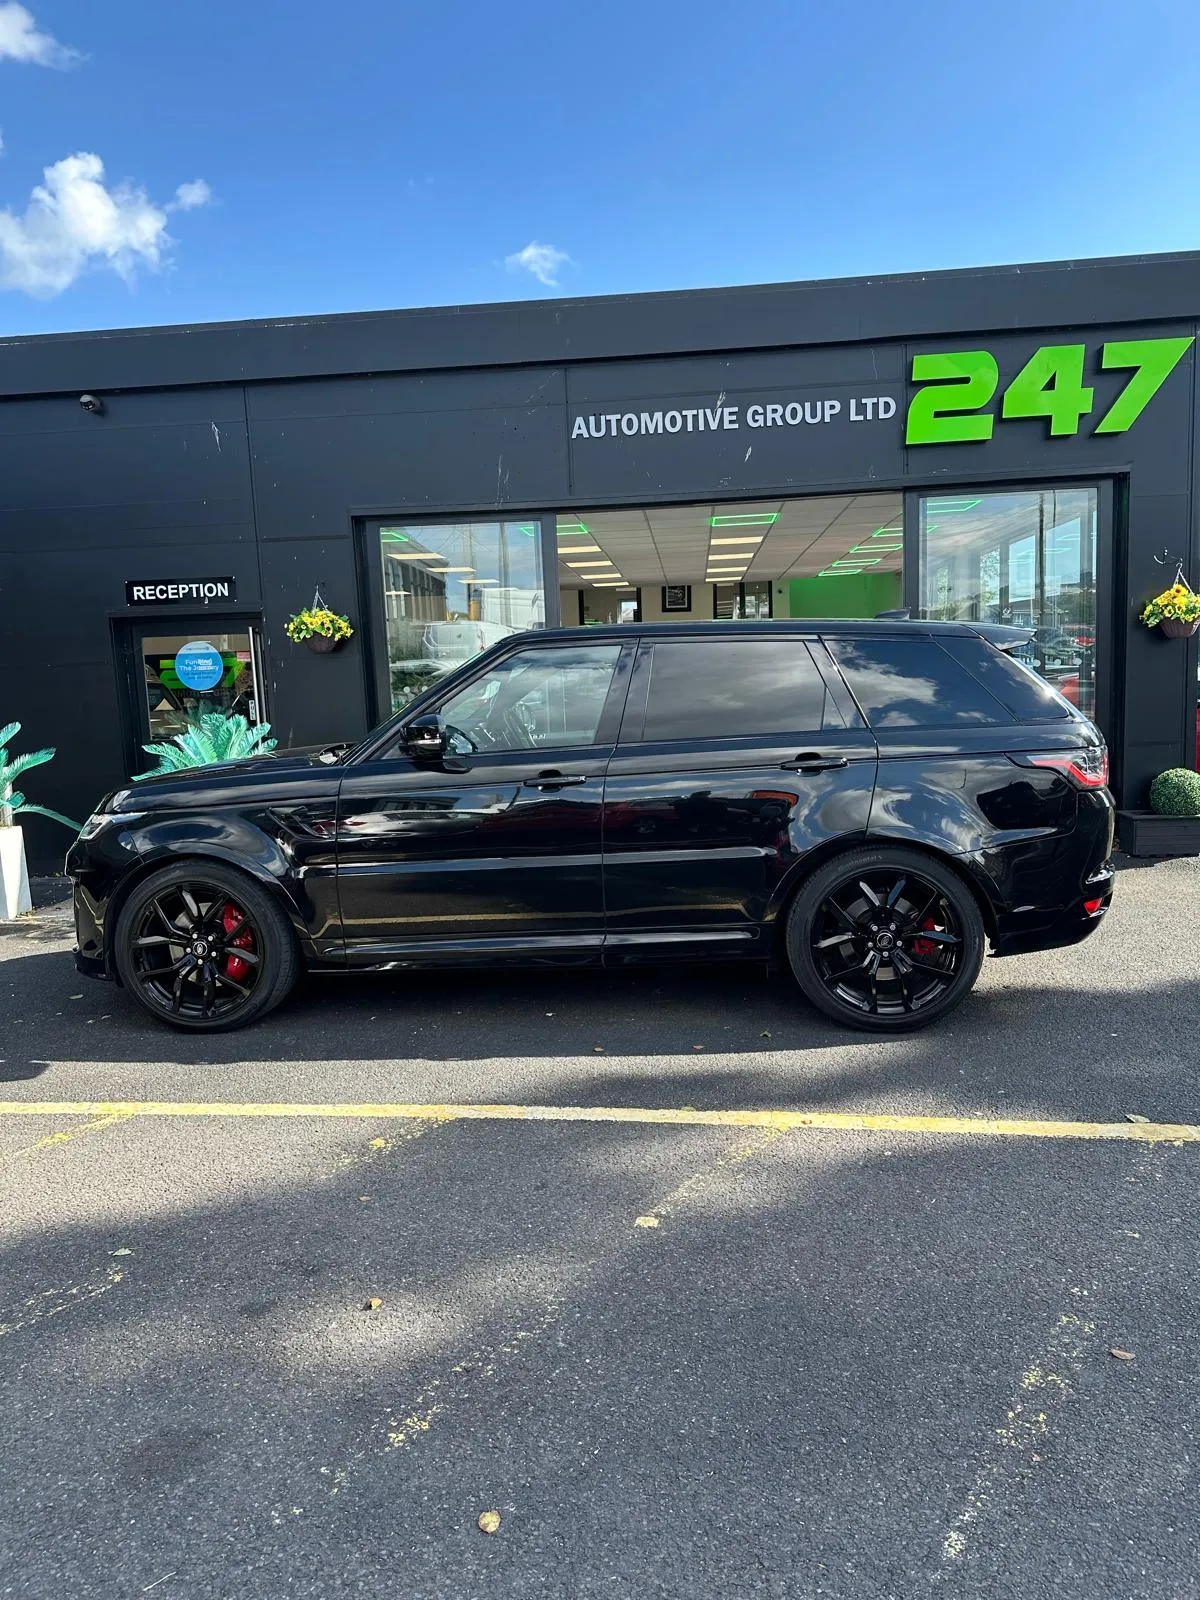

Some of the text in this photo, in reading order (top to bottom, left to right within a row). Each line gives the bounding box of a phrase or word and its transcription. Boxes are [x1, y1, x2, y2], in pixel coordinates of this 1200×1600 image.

[905, 337, 1195, 445] 247
[571, 396, 897, 439] AUTOMOTIVE GROUP LTD
[132, 582, 230, 600] RECEPTION
